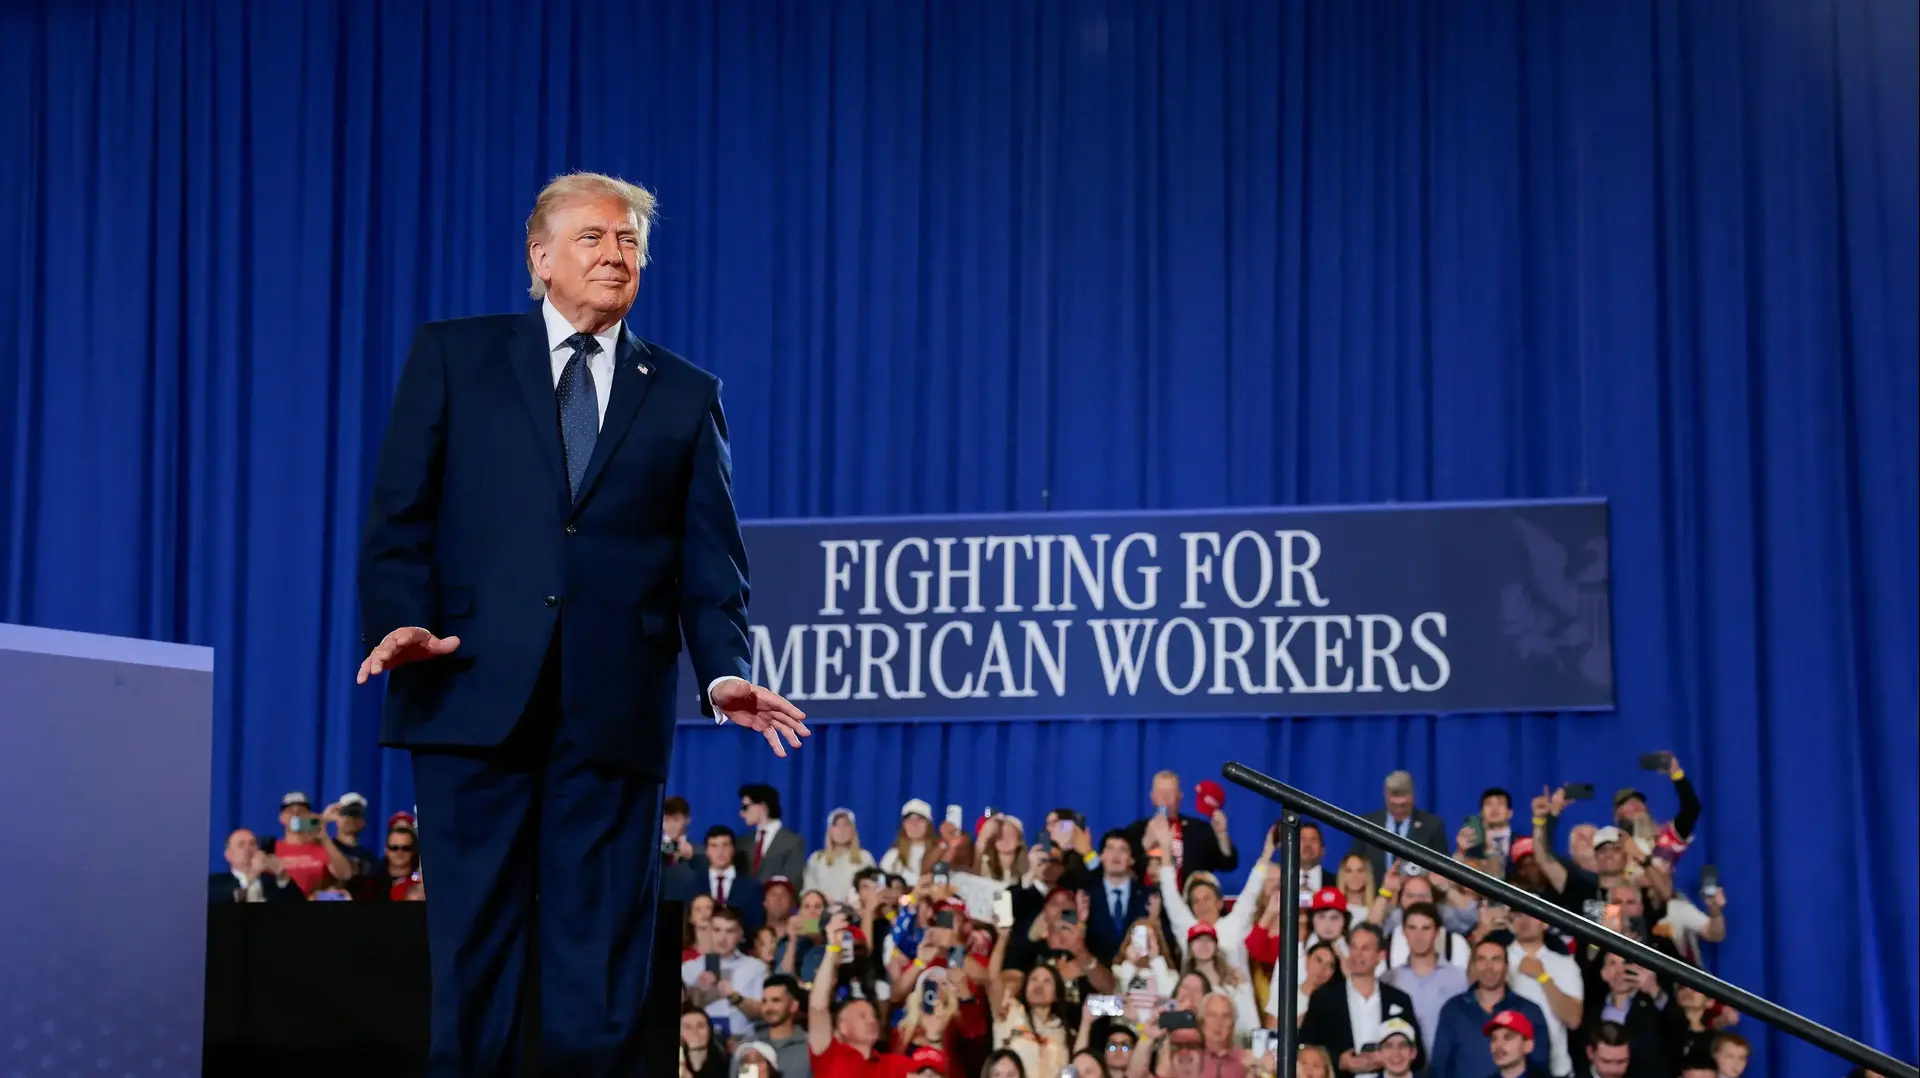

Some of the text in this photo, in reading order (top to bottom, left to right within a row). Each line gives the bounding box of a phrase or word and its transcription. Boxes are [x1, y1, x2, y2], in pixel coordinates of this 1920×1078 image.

[820, 529, 1330, 616] FIGHTING FOR
[696, 612, 1450, 702] MERICAN WORKERS
